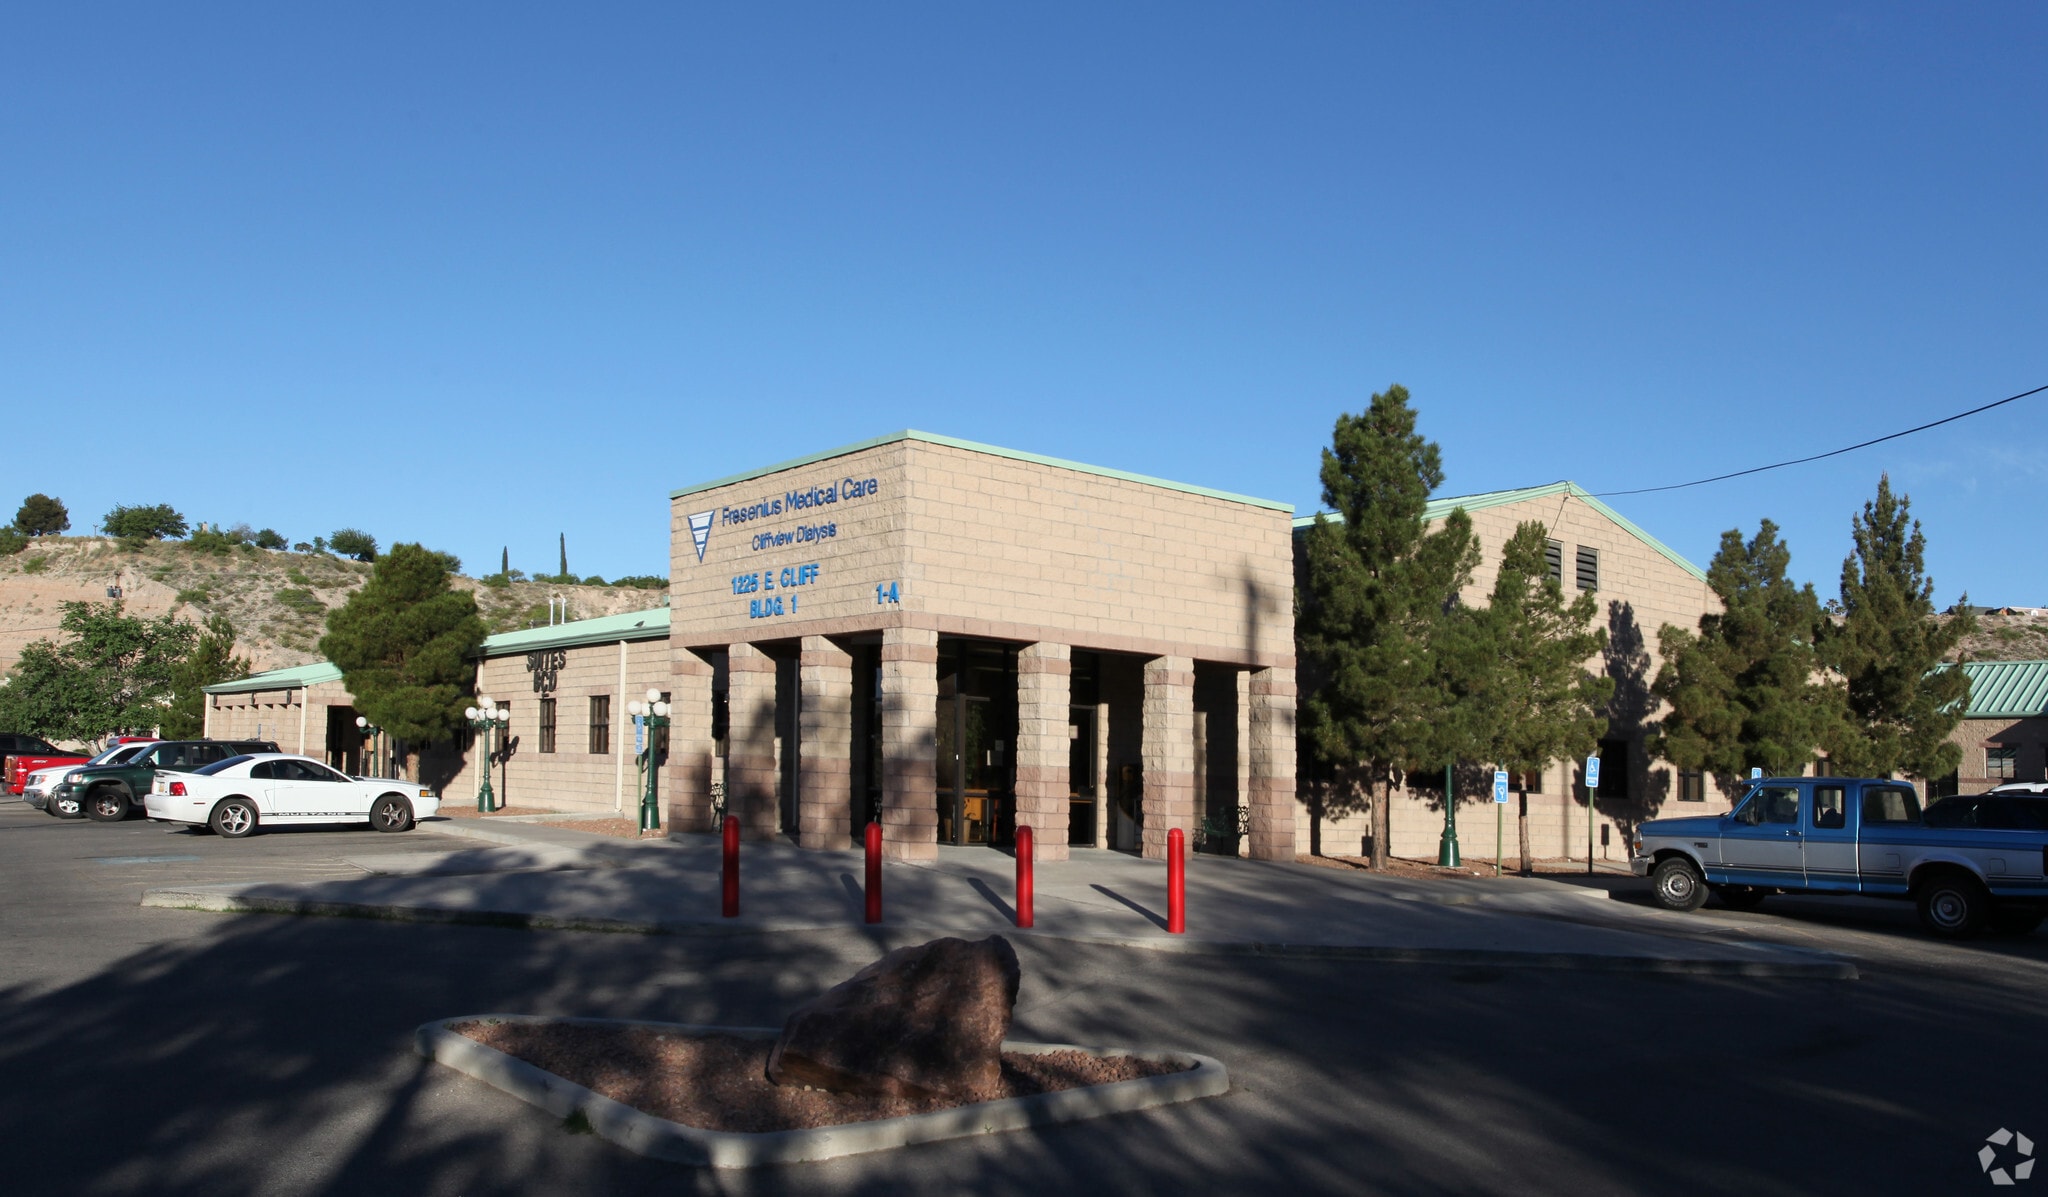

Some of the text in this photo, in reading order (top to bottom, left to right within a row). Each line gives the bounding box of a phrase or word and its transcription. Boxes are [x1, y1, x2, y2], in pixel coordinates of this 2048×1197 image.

[722, 477, 878, 527] Fresenius Medical Care
[752, 521, 837, 551] Cliffview Dialysis
[731, 573, 759, 595] 1225
[780, 563, 820, 588] CLIFF
[791, 594, 798, 613] 1
[876, 581, 900, 604] 1-A
[526, 650, 567, 672] SUITES
